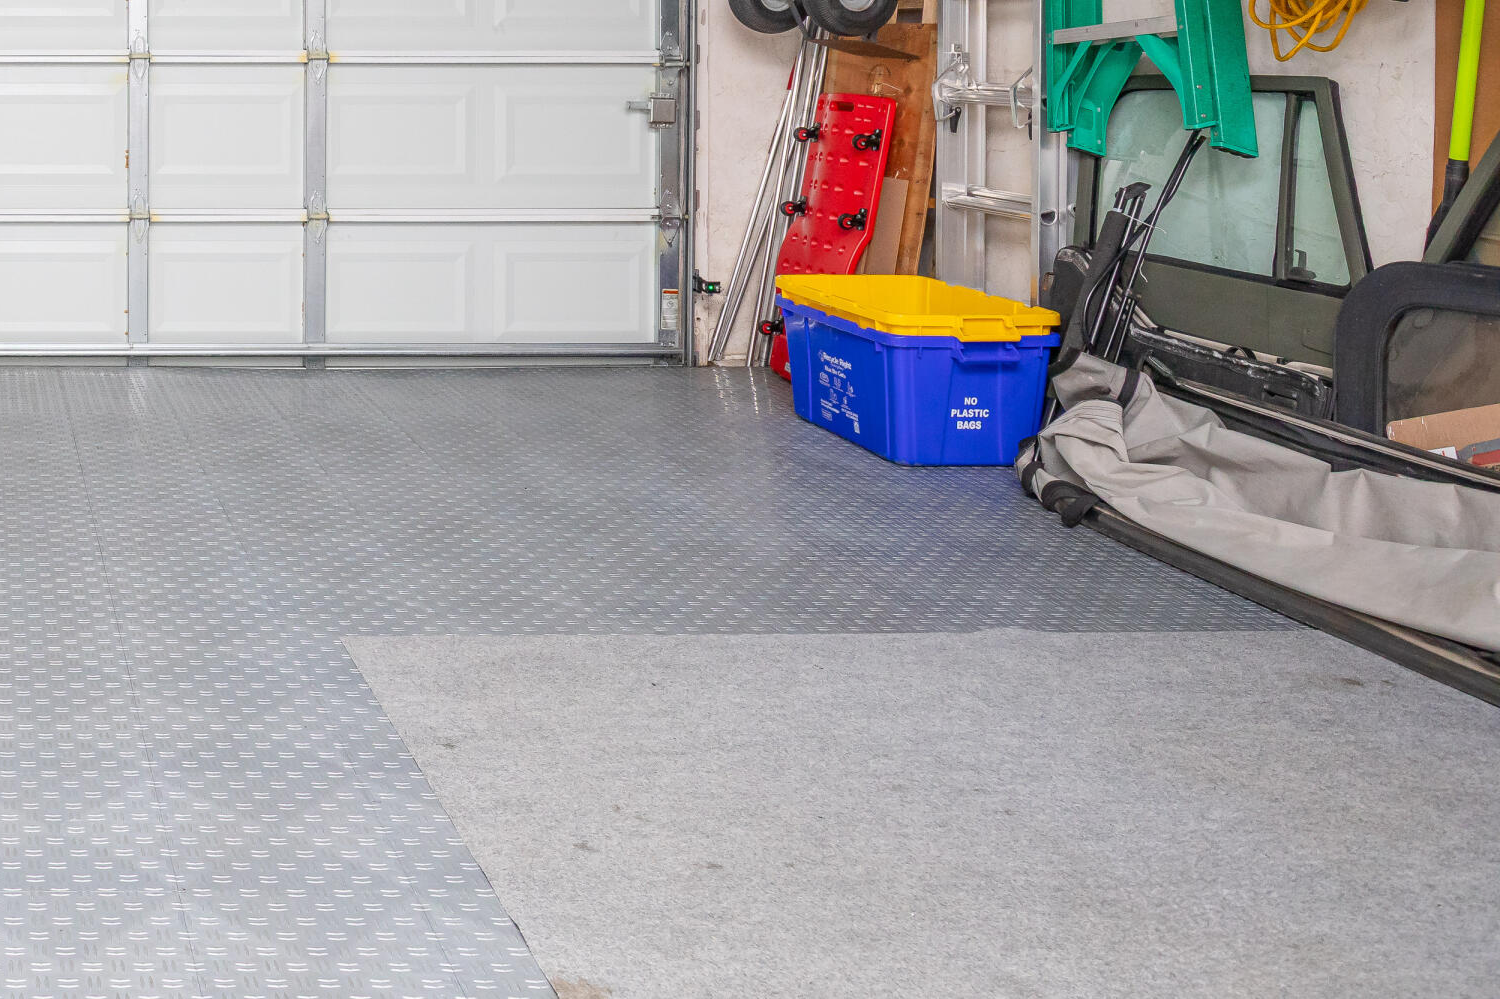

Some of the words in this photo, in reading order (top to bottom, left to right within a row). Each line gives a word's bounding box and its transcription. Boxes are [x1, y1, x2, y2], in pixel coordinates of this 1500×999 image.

[964, 397, 978, 406] NO
[950, 408, 989, 418] PLASTIC
[956, 420, 982, 430] BAGS
